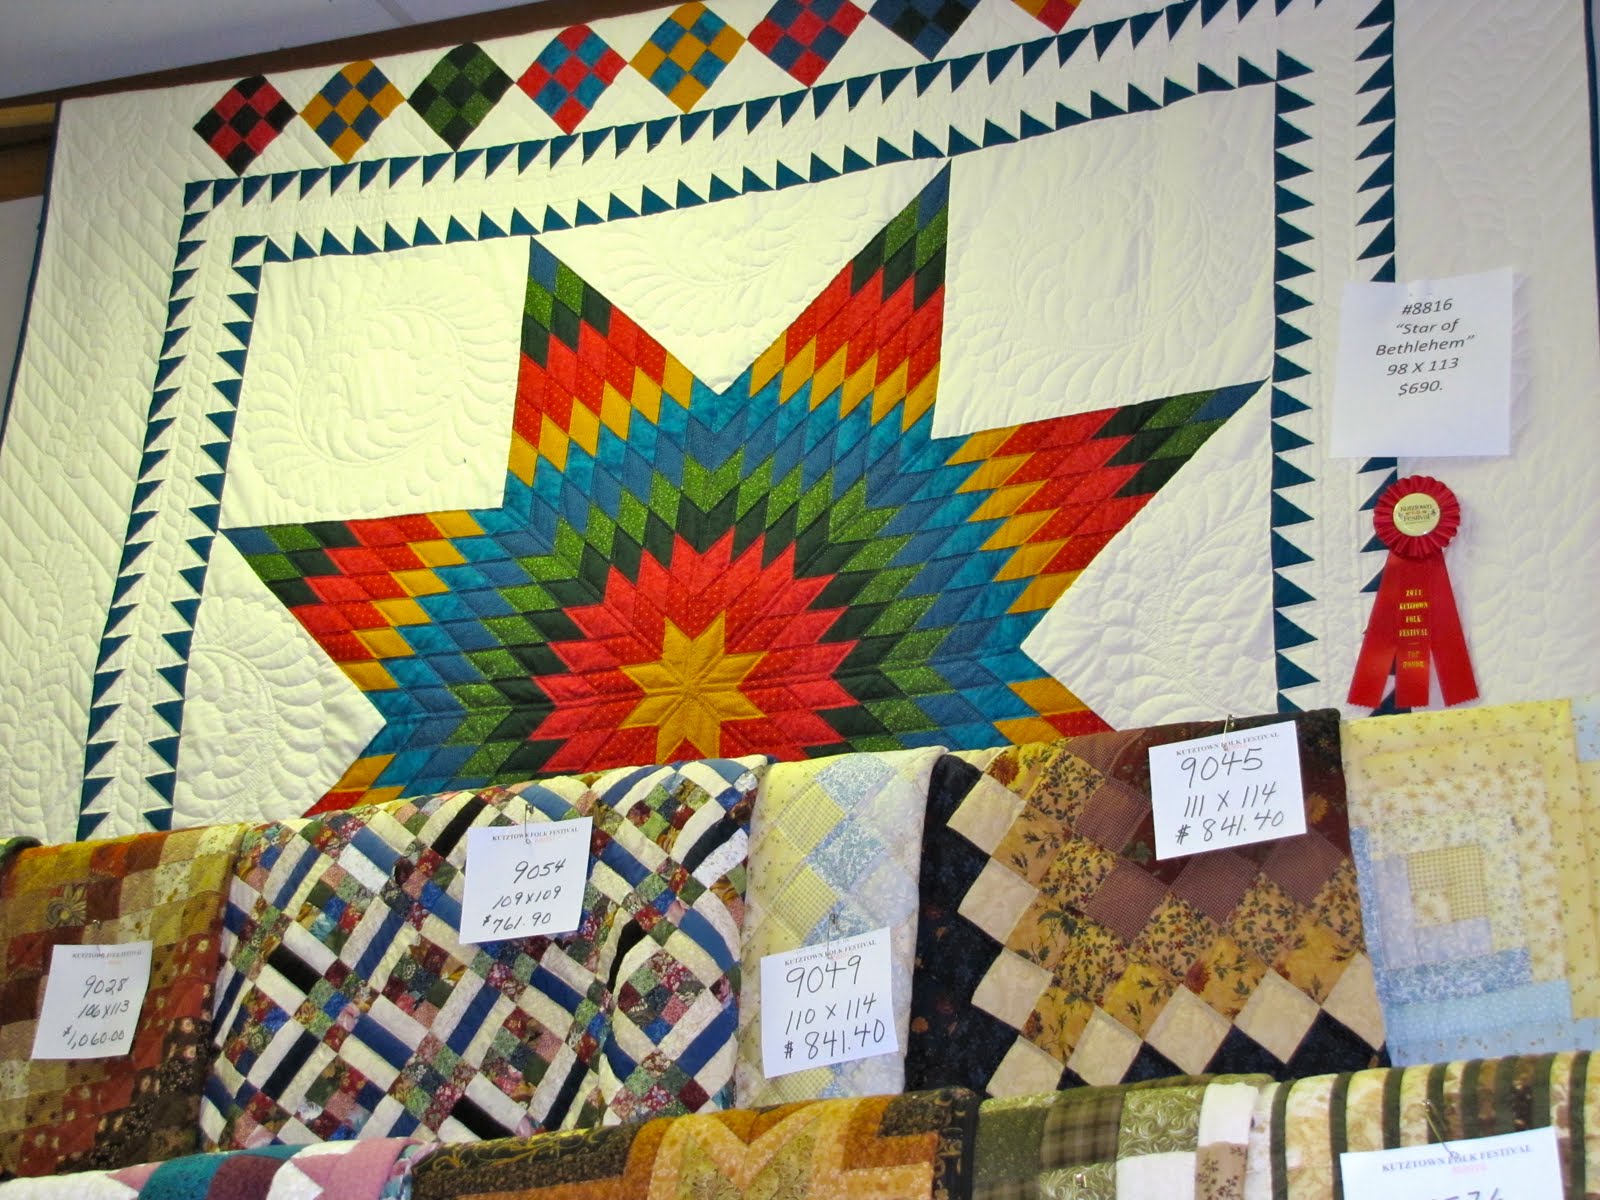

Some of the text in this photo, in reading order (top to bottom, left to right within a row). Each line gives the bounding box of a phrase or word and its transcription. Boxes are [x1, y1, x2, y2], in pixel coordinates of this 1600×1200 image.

[1402, 298, 1453, 315] #8816
[1441, 318, 1460, 333] of
[1386, 358, 1459, 376] 98 X 113
[1397, 380, 1443, 396] $690.
[1405, 615, 1422, 623] FOLK
[1399, 628, 1428, 637] FESTIVAL
[1176, 744, 1219, 756] KUTZTOWN
[1243, 732, 1280, 743] FESTIVAL
[1180, 747, 1263, 788] 9045
[1184, 795, 1205, 818] 111
[1241, 781, 1277, 808] 114
[492, 833, 529, 841] KUTZTOWN
[549, 827, 578, 836] FESTIVAL
[513, 858, 566, 884] 9054
[482, 912, 551, 933] $761.90
[784, 952, 824, 966] KUTZTOWN
[844, 939, 876, 953] FESTIVAL
[83, 975, 129, 998] 9028
[786, 955, 862, 998] 9049
[785, 1008, 816, 1035] 110
[847, 993, 876, 1020] 114
[62, 1025, 125, 1050] $1,060.00
[1381, 1156, 1445, 1173] KUTZTOWN
[1480, 1144, 1531, 1160] FESTIVAL
